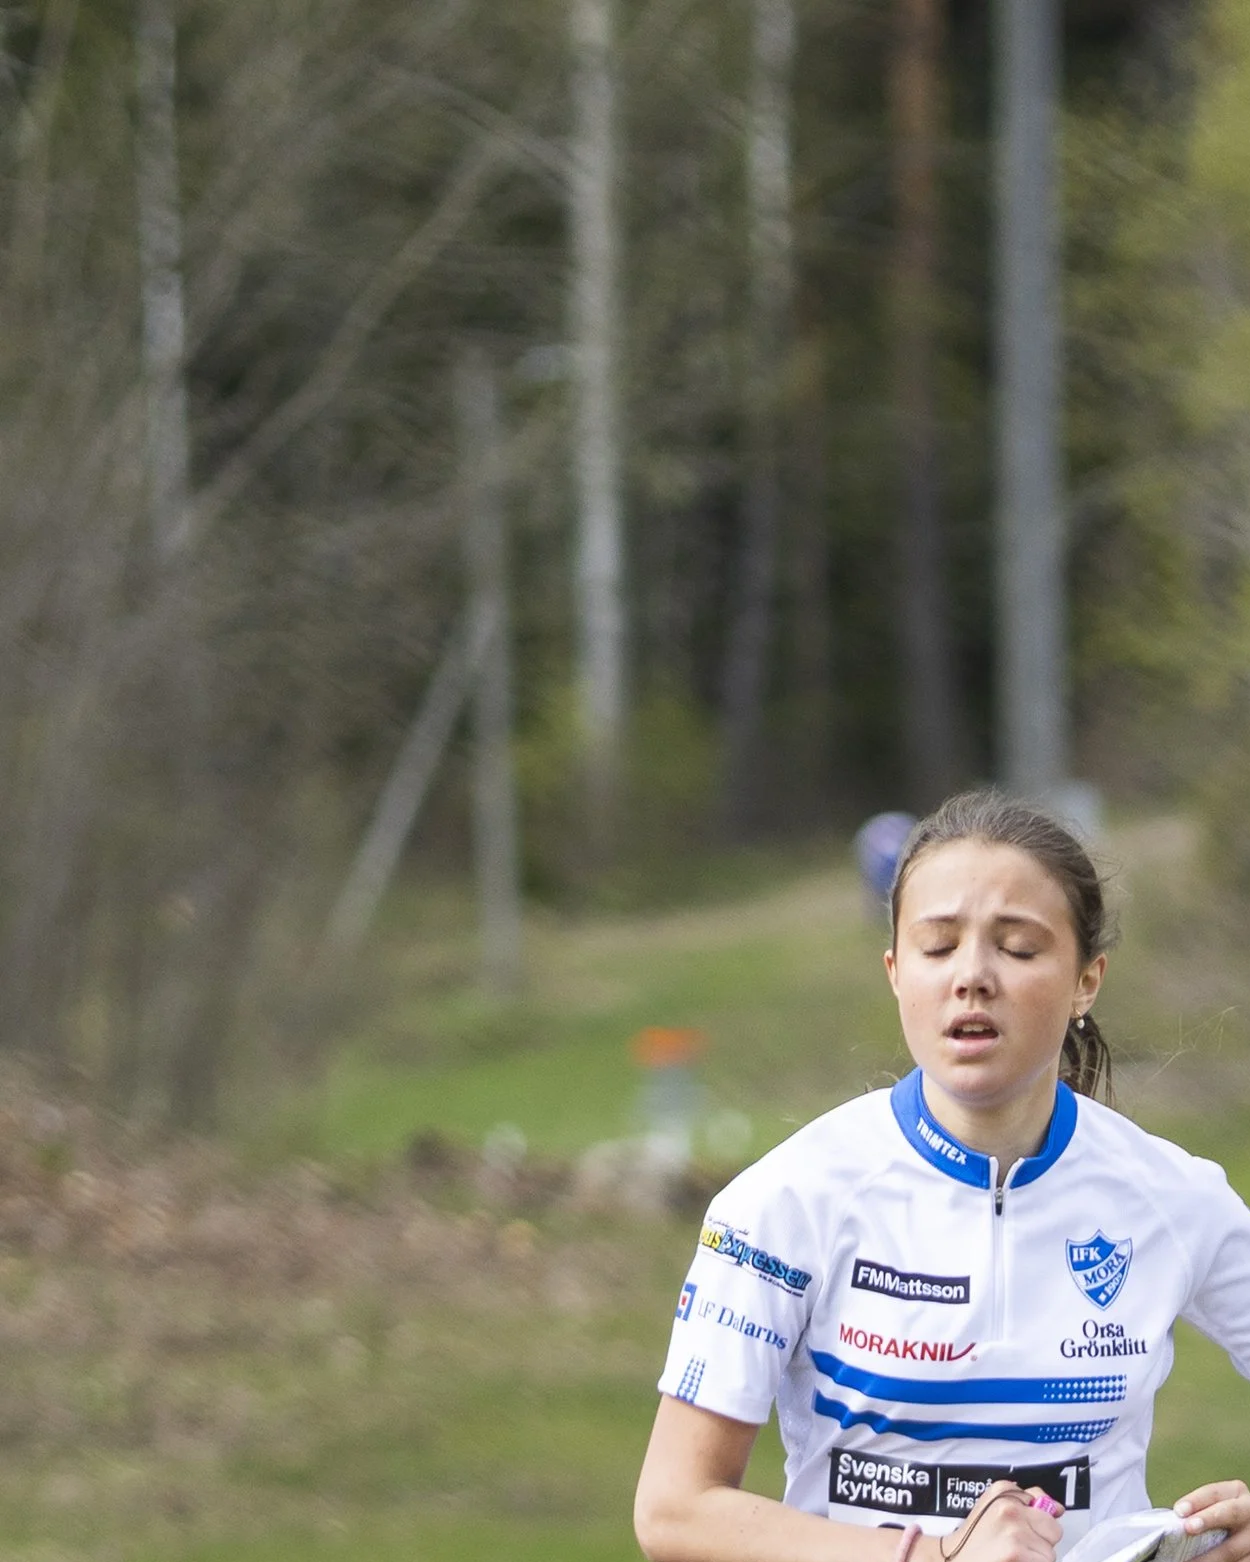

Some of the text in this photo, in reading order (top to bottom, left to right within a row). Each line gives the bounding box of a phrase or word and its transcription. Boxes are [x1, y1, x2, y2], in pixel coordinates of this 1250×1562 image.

[915, 1116, 967, 1166] TRIMTEX
[1071, 1246, 1102, 1263] IFK
[1083, 1251, 1126, 1287] MORA
[857, 1265, 965, 1299] FMMattsson
[1082, 1319, 1125, 1339] Orsa
[1060, 1338, 1149, 1359] Grönklitt
[838, 1452, 930, 1486] Svenska
[836, 1475, 913, 1506] kyrkan
[945, 1494, 977, 1508] förs
[1059, 1465, 1078, 1507] 1
